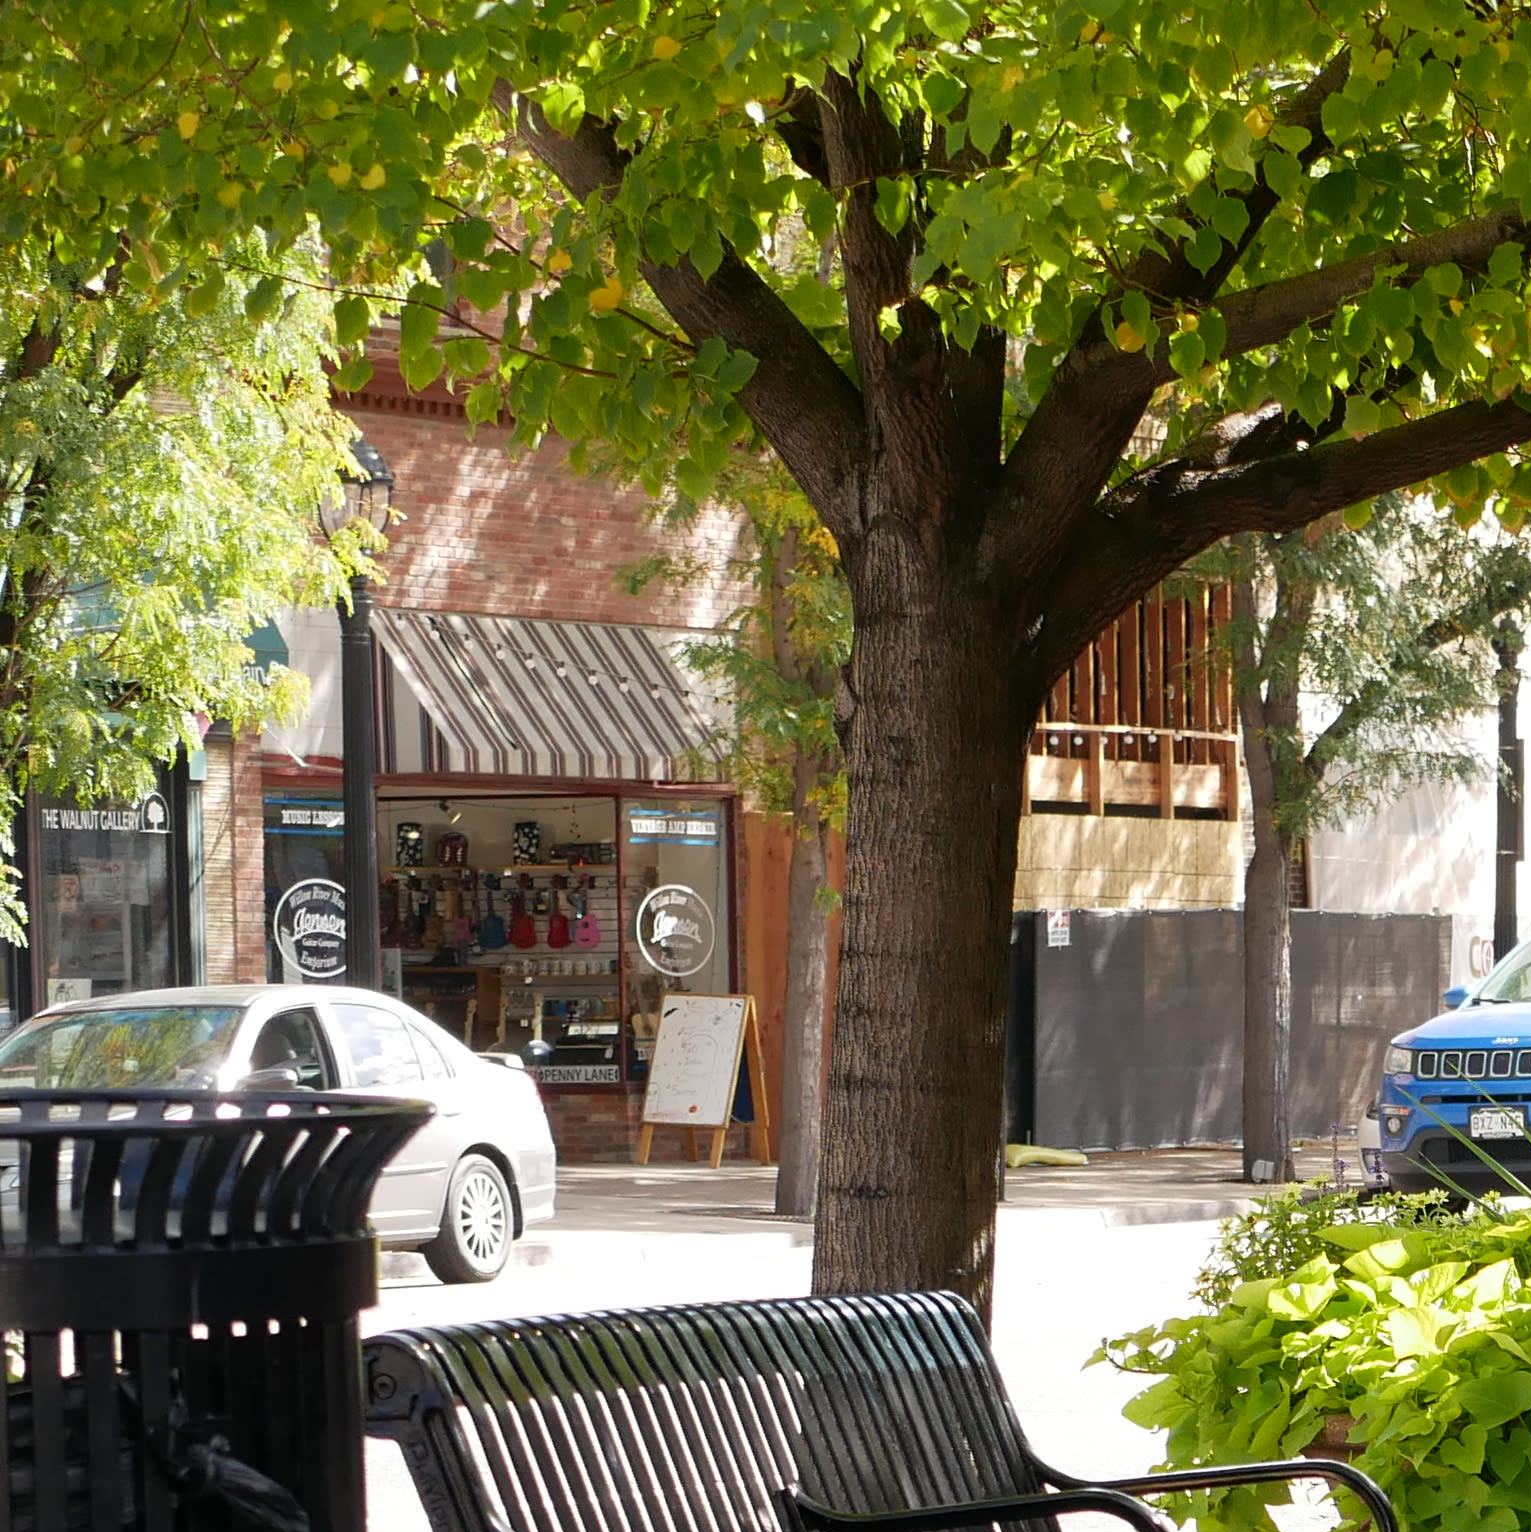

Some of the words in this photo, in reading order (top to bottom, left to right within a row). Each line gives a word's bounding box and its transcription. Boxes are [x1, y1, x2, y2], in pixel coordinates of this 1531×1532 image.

[42, 809, 58, 829] THE
[60, 810, 99, 830] WALNUT
[100, 811, 140, 831] GALLERY
[544, 1068, 582, 1082] PENNY
[584, 1068, 614, 1082] LANE
